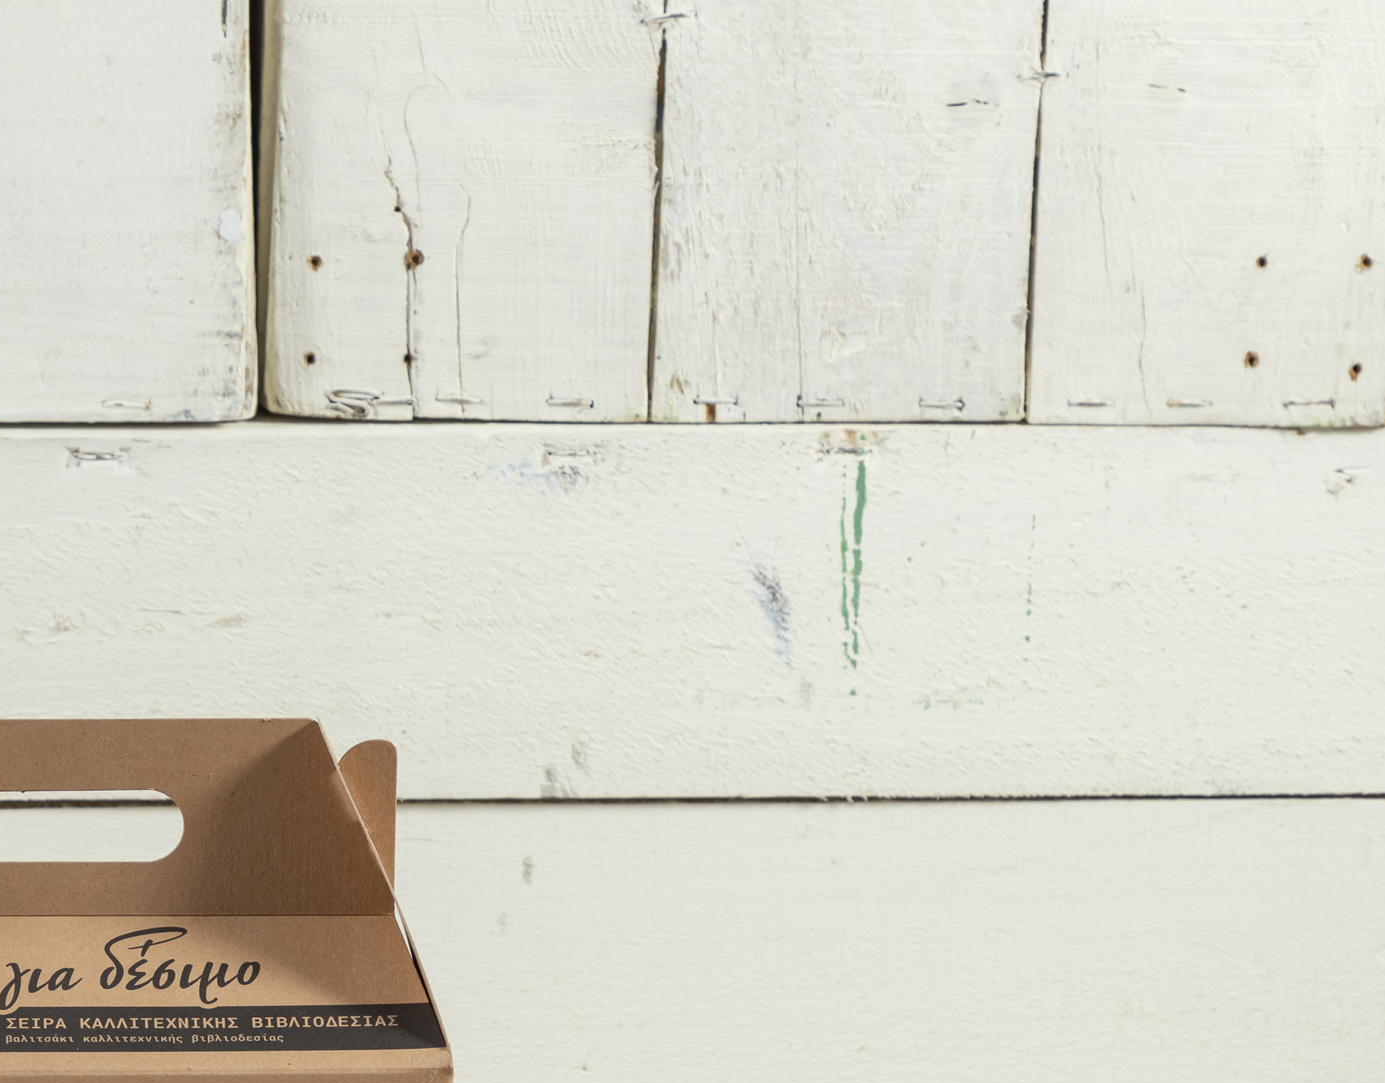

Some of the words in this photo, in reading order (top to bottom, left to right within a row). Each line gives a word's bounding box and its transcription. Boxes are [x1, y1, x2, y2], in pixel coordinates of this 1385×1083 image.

[100, 926, 261, 1005] δέσιμο
[5, 1017, 67, 1030] ΣΕΙΡΑ
[79, 1016, 239, 1030] ΚΑΛΛΙΤΕΧΝΙΚΗΣ
[251, 1014, 399, 1030] ΒΙΒΛΙΟΔΕΣΙΑΣ
[5, 1033, 75, 1046] βαλιτσάκι
[83, 1033, 183, 1046] καλλιτεχνικής
[191, 1032, 284, 1045] βιβλιοδεσίας
